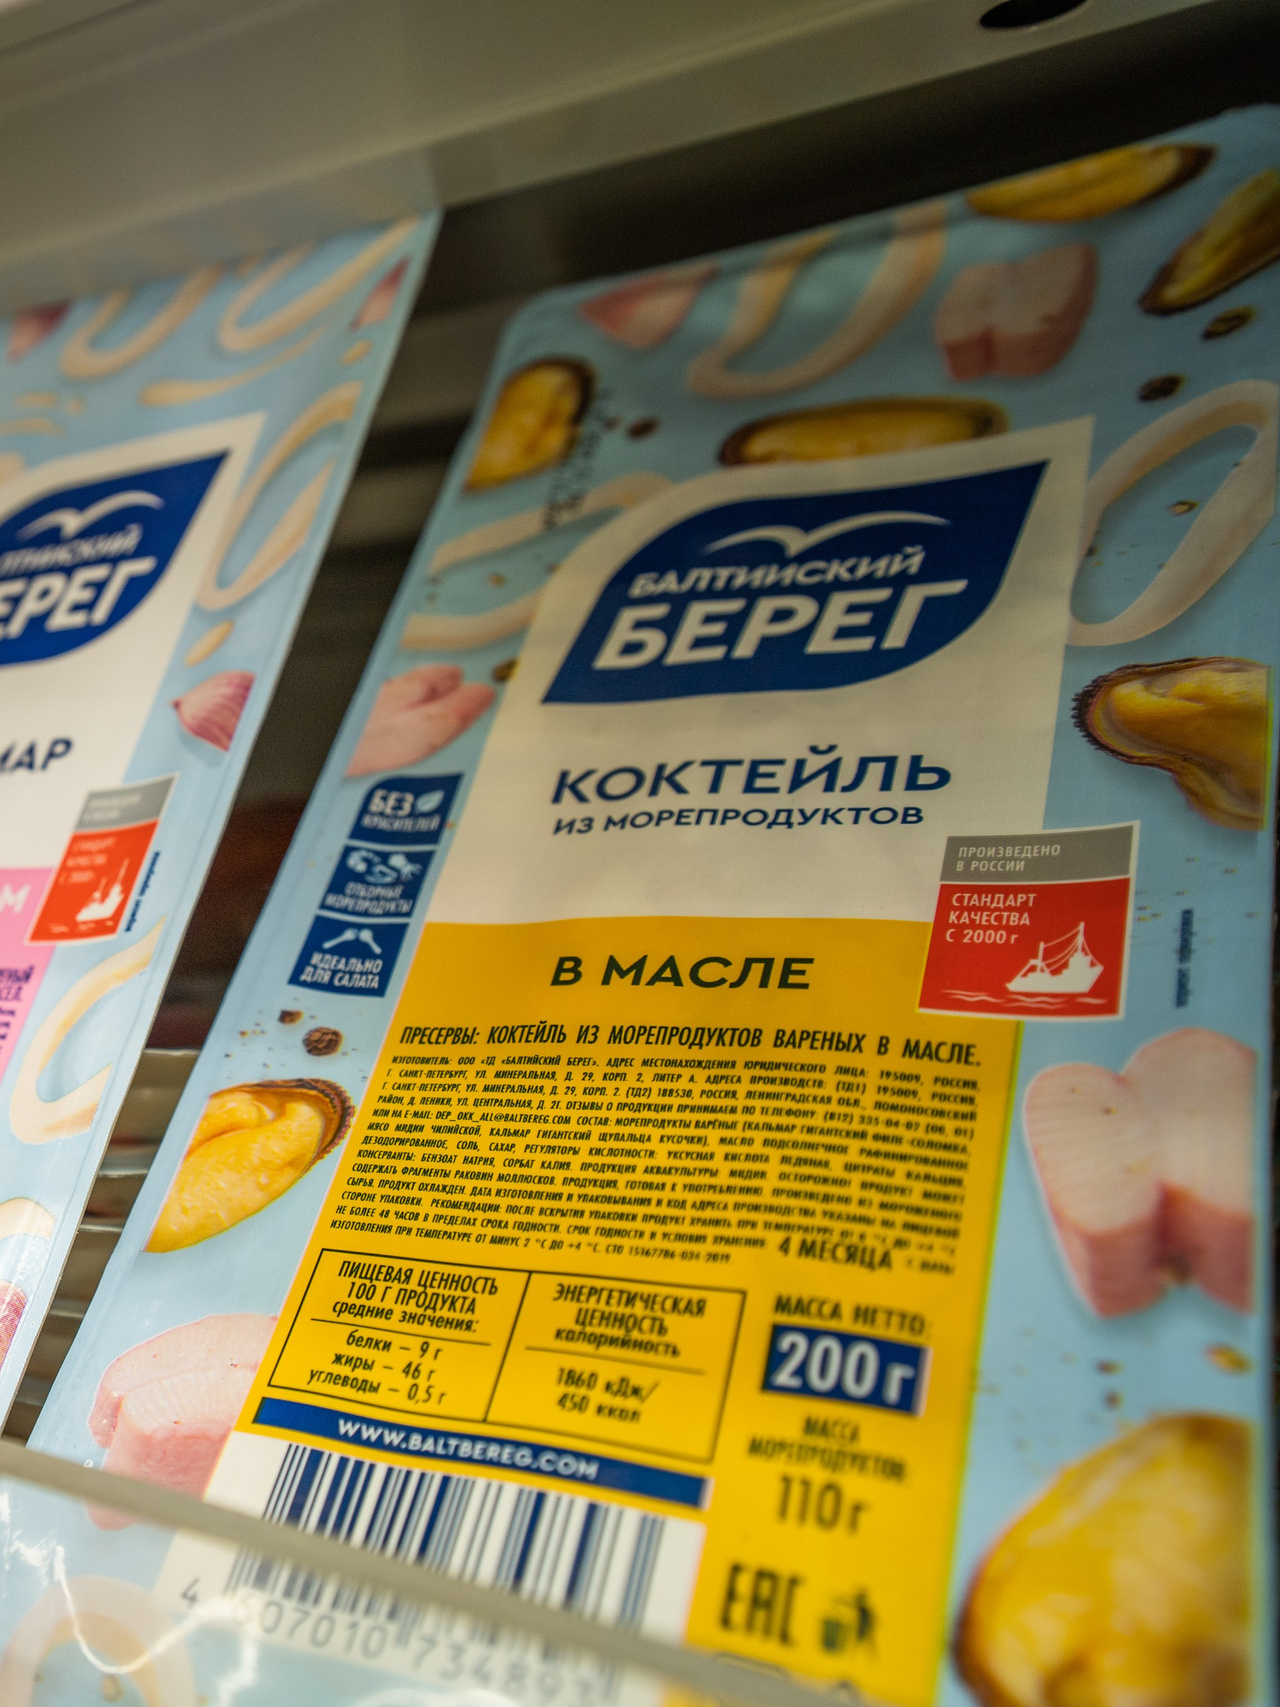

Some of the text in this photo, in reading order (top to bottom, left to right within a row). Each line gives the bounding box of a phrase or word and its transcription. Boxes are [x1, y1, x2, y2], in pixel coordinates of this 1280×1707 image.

[592, 579, 969, 670] БЕРЕГ
[551, 744, 952, 805] КОКТЕЙЛЬ
[369, 789, 415, 817] БЕЗ
[361, 813, 442, 832] КРАСИТЕЛЕЙ
[553, 806, 924, 835] ИЗ МОРЕПРОДУКТОВ
[958, 844, 1061, 859] ПРОИЗВЕДЕНО
[956, 860, 1025, 872] В РОССИИ
[344, 881, 405, 900] ОТБОРНЫЕ
[951, 893, 1037, 909] СТАНДАРТ
[324, 892, 414, 916] МОРЕПРОДУКТЫ
[948, 911, 1031, 927] КАЧЕСТВА
[946, 929, 1020, 945] С 2000 г
[310, 952, 383, 974] ИДЕАЛЬНО
[550, 955, 816, 990] В МАСЛЕ
[299, 966, 380, 989] ДЛЯ САЛАТА
[399, 1024, 981, 1067] ПРЕСЕРВЫ: КОКТЕЙЛЬ ИЗ МОРЕПРОДУКТОВ ВАРЕНЫХ В МАСЛЕ.
[386, 1068, 487, 1080] Г. САНКТ-ПЕТЕРБУРГ, УЛ.
[391, 1055, 497, 1067] ИЗГОТОВИТЕЛЬ: ООО «ТД
[381, 1081, 546, 1096] Г. САНКТ-ПЕТЕРБУРГ, УЛ. МИНЕРАЛЬНАЯ,
[371, 1108, 434, 1120] ИЛИ НА E-MAIL:
[377, 1093, 545, 1111] РАЙОН, Д. ПЕНИКИ, УЛ. ЦЕНТРАЛЬНАЯ, Д.
[366, 1122, 531, 1138] МЯСО МИДИИ ЧИЛИЙСКОЙ, КАЛЬМАР
[360, 1135, 516, 1154] ДЕЗОДОРИРОВАННОЕ, СОЛЬ, САХАР,
[351, 1162, 494, 1182] СОДЕРЖАТЬ ФРАГМЕНТЫ РАКОВИН
[356, 1149, 536, 1169] КОНСЕРВАНТЫ: БЕНЗОАТ НАТРИЯ, СОРБАТ
[346, 1176, 492, 1197] СЫРЬЯ. ПРОДУКТ ОХЛАЖДЕН. ДАТА
[341, 1190, 535, 1216] СТОРОНЕ УПАКОВКИ. РЕКОМЕНДАЦИИ: ПОСЛЕ
[335, 1204, 509, 1230] НЕ БОЛЕЕ 48 ЧАСОВ В ПРЕДЕЛАХ СРОКА
[329, 1219, 394, 1234] ИЗГОТОВЛЕНИЯ
[394, 1225, 413, 1236] ПРИ
[415, 1227, 473, 1243] ТЕМПЕРАТУРЕ
[474, 1233, 488, 1244] ОТ
[488, 1234, 521, 1247] МИНУС
[523, 1237, 531, 1248] 2
[779, 1236, 792, 1258] 4
[796, 1239, 893, 1272] МЕСЯЦА
[338, 1260, 498, 1296] ПИЩЕВАЯ ЦЕННОСТЬ
[347, 1281, 477, 1314] 100 Г ПРОДУКТА
[553, 1283, 707, 1318] ЭНЕРГЕТИЧЕСКАЯ
[773, 1295, 843, 1321] МАССА
[332, 1300, 479, 1333] средние значения:
[575, 1308, 668, 1337] ЦЕННОСТЬ
[346, 1329, 392, 1352] белки
[419, 1341, 430, 1359] 9
[433, 1348, 443, 1360] г
[555, 1327, 681, 1358] калорийность
[331, 1352, 375, 1372] жиры
[402, 1361, 421, 1379] 46
[427, 1370, 436, 1382] г
[772, 1331, 879, 1398] 200
[307, 1369, 381, 1394] углеводы
[407, 1383, 433, 1405] 0,5
[437, 1391, 447, 1405] г
[556, 1367, 598, 1391] 1860
[557, 1393, 590, 1414] 450
[803, 1416, 860, 1444] МАССА
[338, 1419, 600, 1480] WWW.BALTBEREG.COM
[181, 1578, 201, 1609] 4
